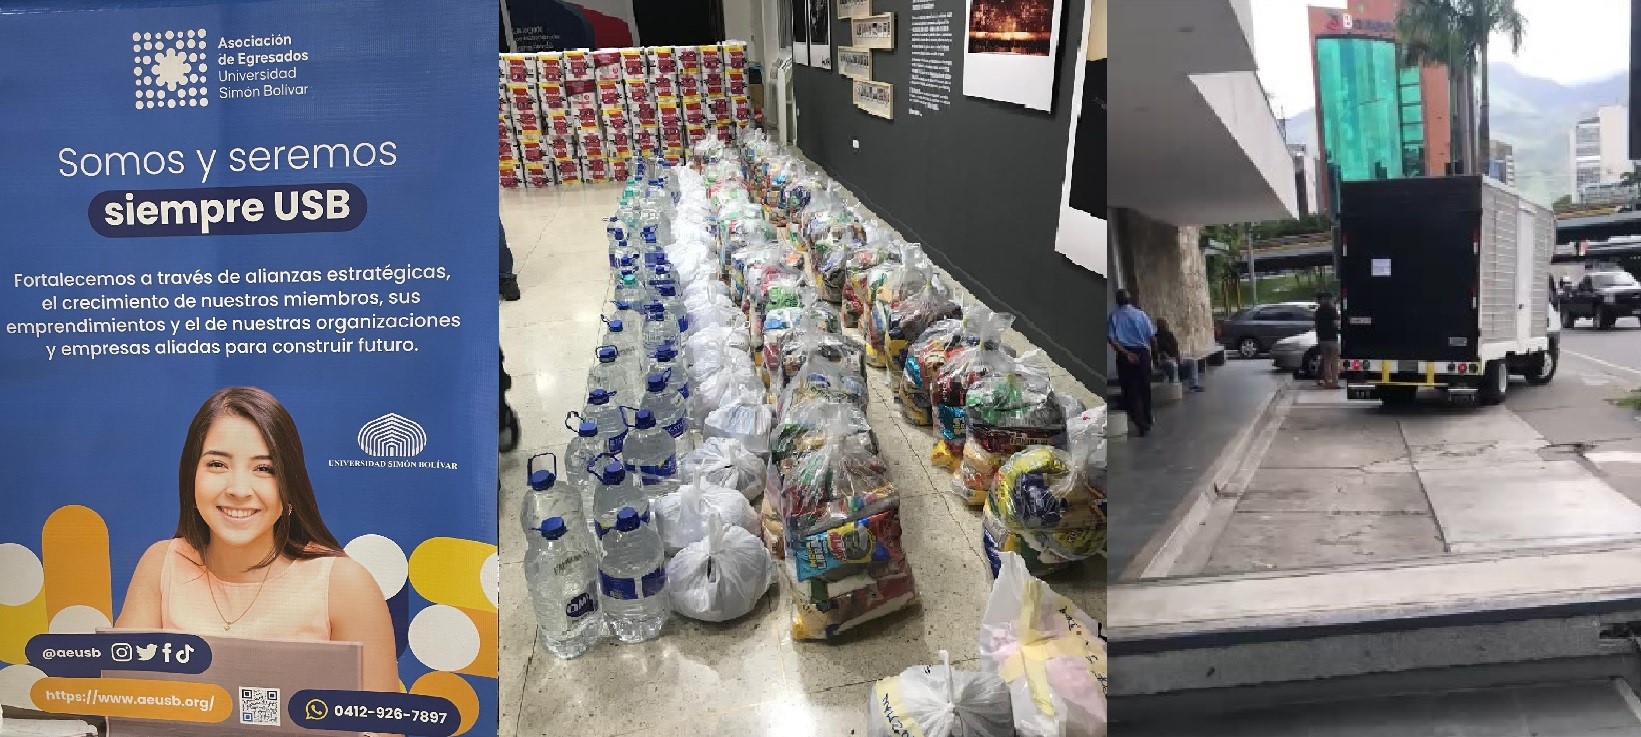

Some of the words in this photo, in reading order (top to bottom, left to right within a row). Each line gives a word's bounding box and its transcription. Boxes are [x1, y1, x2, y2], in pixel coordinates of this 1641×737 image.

[218, 34, 291, 48] Asociación
[218, 54, 234, 65] de
[238, 50, 308, 66] Egresados
[219, 66, 296, 81] Universidad
[220, 86, 259, 98] Simón
[264, 83, 308, 96] Bolívar
[59, 148, 184, 176] Somos
[196, 150, 216, 183] y
[230, 142, 396, 171] seremos
[105, 193, 264, 233] siempre
[275, 190, 349, 220] USB
[15, 273, 135, 287] Fortalecemos
[141, 274, 152, 285] a
[158, 269, 212, 284] través
[218, 270, 240, 283] de
[246, 268, 321, 283] alianzas
[327, 264, 450, 284] estratégicas,
[42, 296, 56, 310] el
[63, 294, 169, 309] crecimiento
[174, 294, 196, 308] de
[202, 294, 278, 307] nuestros
[285, 291, 383, 306] miembros,
[389, 292, 420, 304] sus
[7, 318, 165, 337] emprendimientos
[171, 320, 180, 335] y
[186, 317, 199, 330] el
[205, 317, 227, 330] de
[233, 317, 310, 330] nuestras
[317, 313, 460, 333] organizaciones
[46, 346, 56, 360] y
[62, 344, 150, 359] empresas
[155, 340, 220, 354] aliadas
[226, 343, 266, 357] para
[273, 338, 353, 353] construir
[358, 338, 418, 352] futuro.
[329, 459, 386, 468] UNIVERSIDAD
[388, 459, 416, 468] SIMÓN
[419, 459, 457, 470] BOLÍVAR
[43, 647, 101, 659] @aeusb
[46, 690, 214, 711] https://www.aeusb.org/
[335, 705, 447, 723] 0412-926-7897
